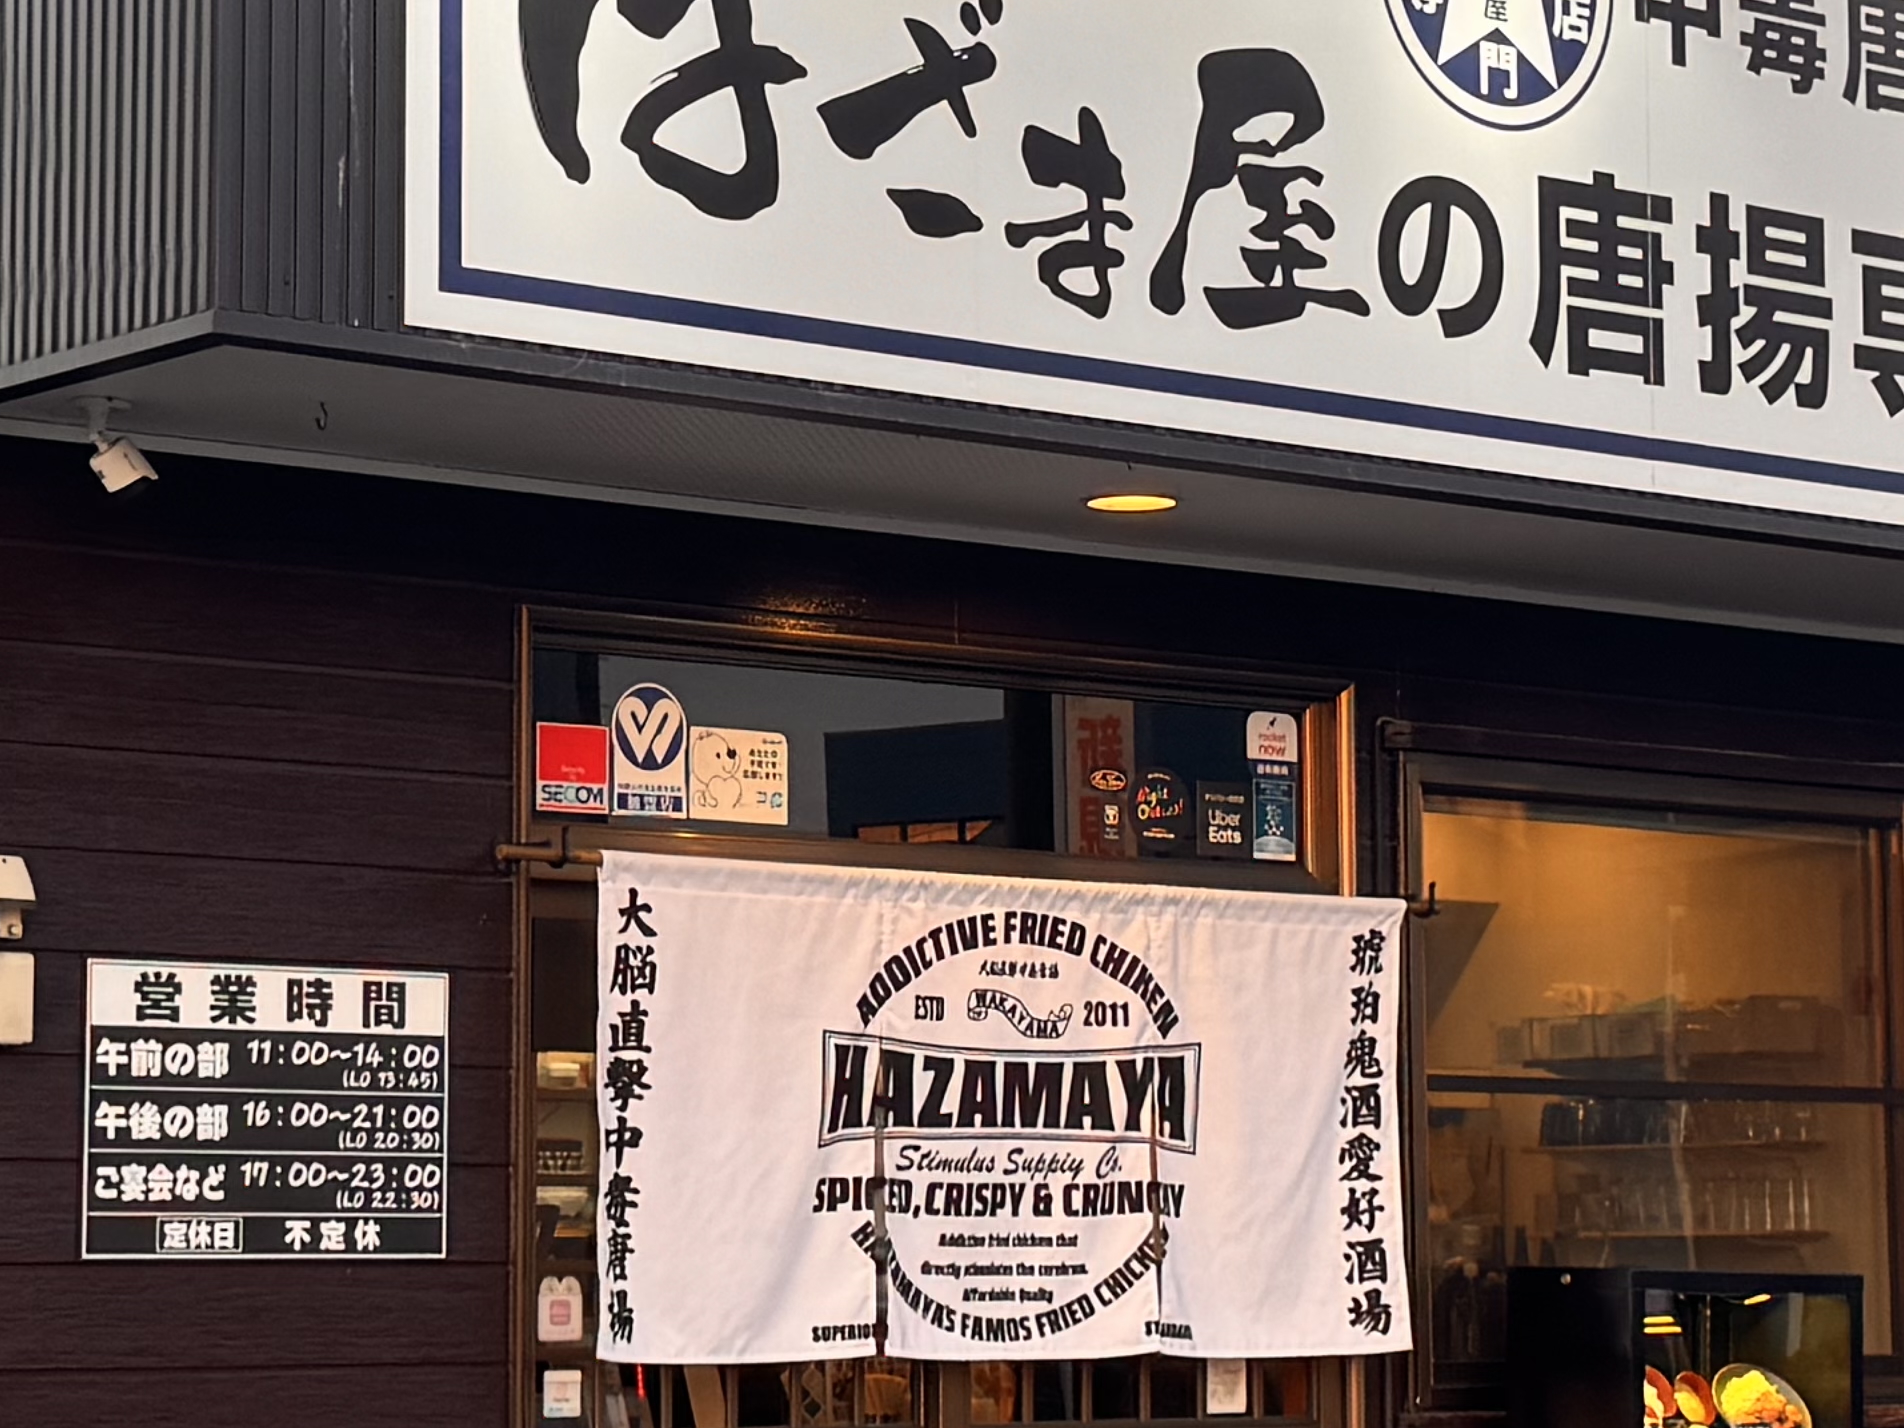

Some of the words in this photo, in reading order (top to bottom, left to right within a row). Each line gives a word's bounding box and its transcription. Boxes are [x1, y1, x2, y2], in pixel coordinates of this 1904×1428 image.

[541, 784, 604, 805] SECOM
[1208, 808, 1241, 826] Uber
[1208, 826, 1242, 844] Eats
[856, 912, 997, 1028] ADDICTIVE
[1004, 911, 1087, 956] FRIED
[134, 971, 406, 1029] 営業時間
[915, 994, 945, 1021] ESTD
[975, 991, 1060, 1038] WAKAYAMA
[1083, 1001, 1130, 1027] 2011
[96, 1038, 229, 1078] 午前の部
[827, 1043, 1187, 1141] HAZAMAYA
[95, 1102, 229, 1142] 午後の部
[896, 1144, 995, 1173] Stimulus
[95, 1163, 226, 1202] ご宴会など
[925, 1182, 1031, 1218] CRISPY
[1033, 1183, 1052, 1217] &
[162, 1222, 236, 1250] 定休日
[284, 1220, 381, 1251] 不定休
[1035, 1294, 1095, 1338] FRIED
